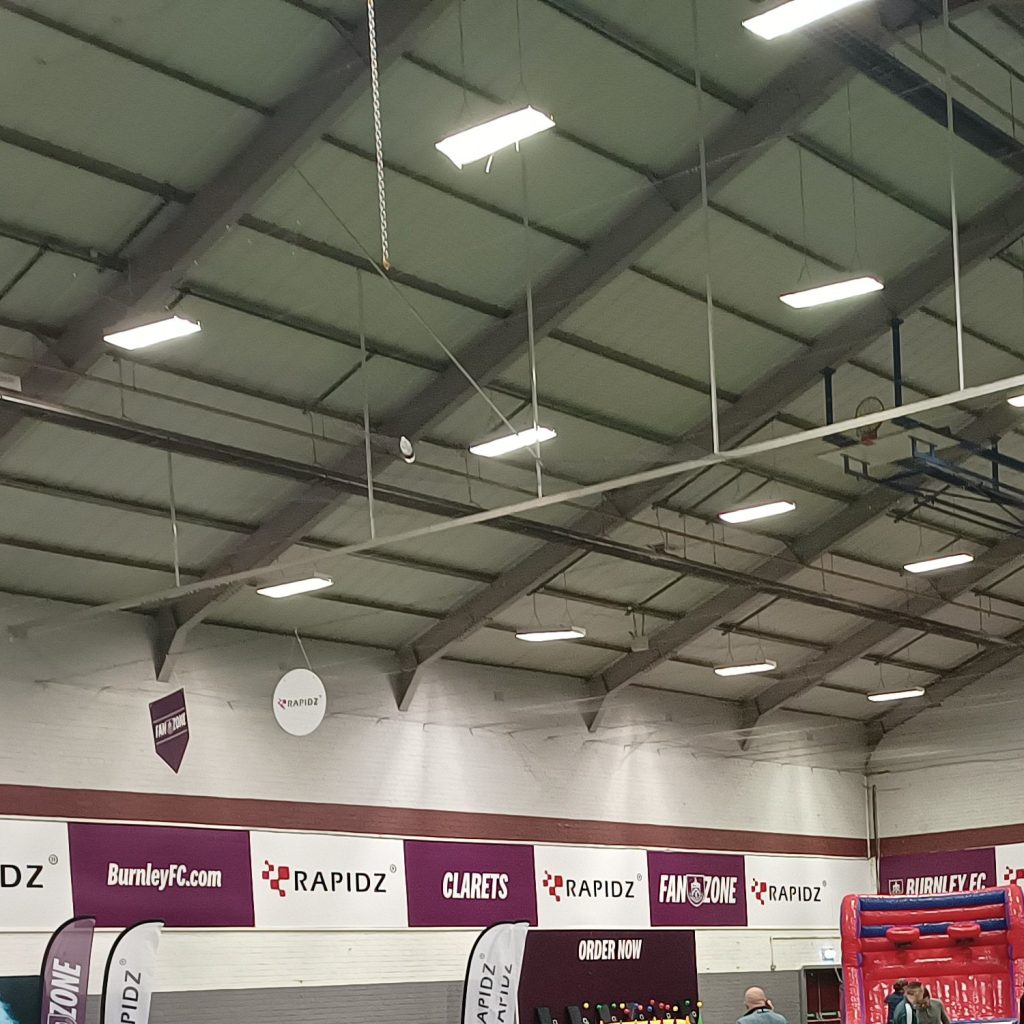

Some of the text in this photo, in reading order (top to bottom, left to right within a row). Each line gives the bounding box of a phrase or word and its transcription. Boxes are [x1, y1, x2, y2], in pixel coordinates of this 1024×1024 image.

[288, 697, 319, 708] RAPIDZ
[107, 862, 222, 891] BurnleyFC.com
[294, 870, 387, 893] RAPIDZ
[442, 871, 509, 900] CLARETS
[969, 872, 987, 890] FC
[566, 879, 635, 899] RAPIDZ
[658, 874, 738, 904] FAN ZONE
[768, 885, 822, 902] RAPIDZ
[578, 939, 643, 961] ORDER NOW
[50, 957, 82, 1021] ZONE
